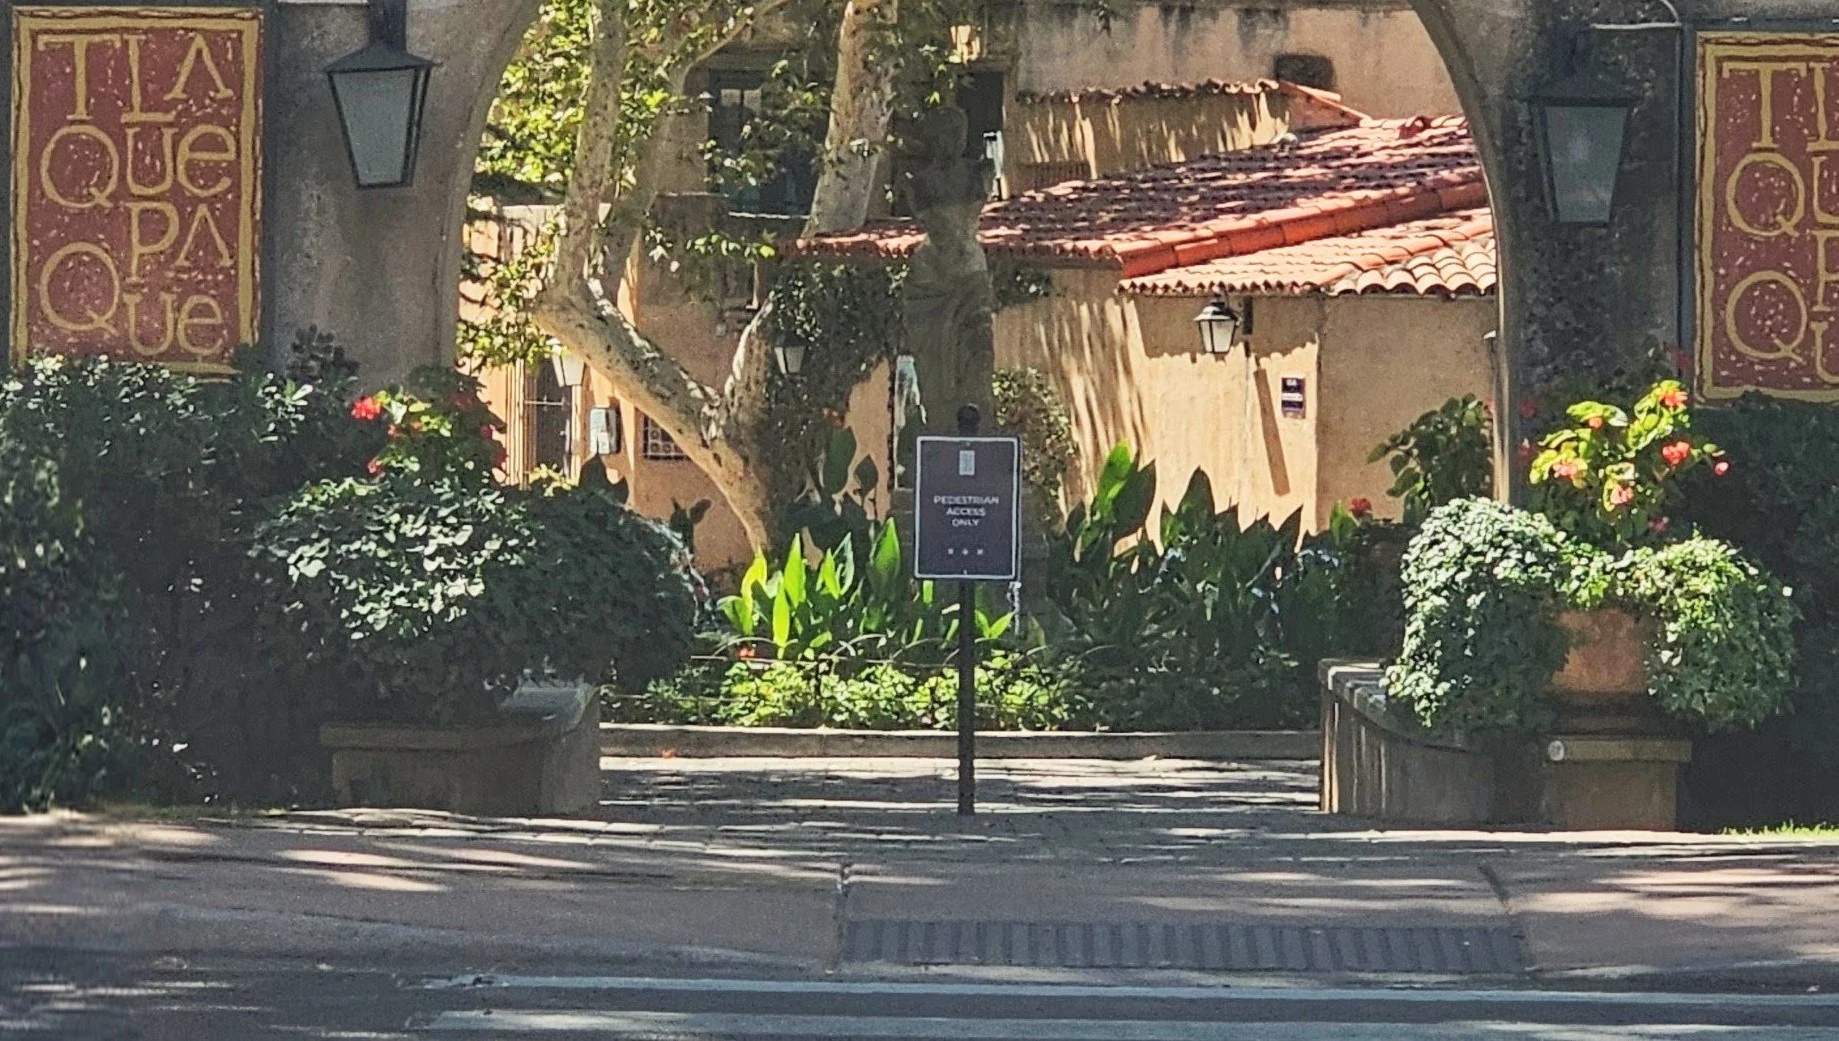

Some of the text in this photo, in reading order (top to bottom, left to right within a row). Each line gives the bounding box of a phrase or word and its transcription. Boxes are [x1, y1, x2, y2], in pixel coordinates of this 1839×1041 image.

[37, 32, 235, 124] TLA
[933, 495, 1000, 505] PEDESTRIAN
[946, 507, 986, 517] ACCESS
[951, 518, 980, 528] ONLY
